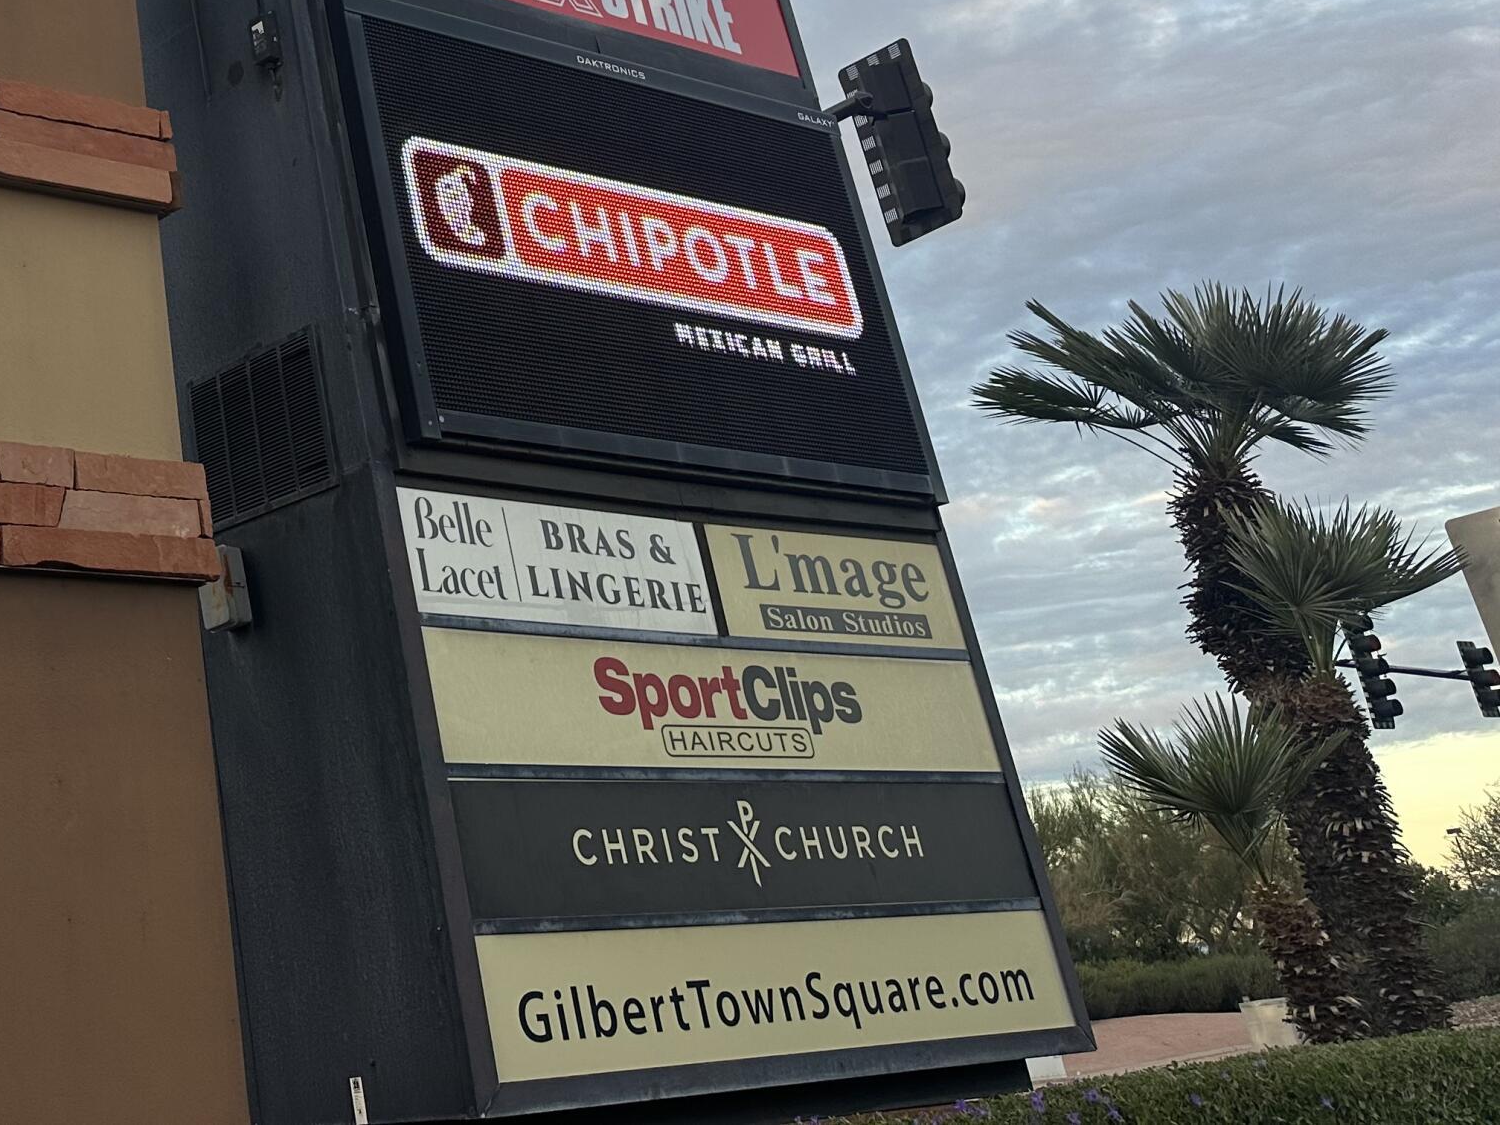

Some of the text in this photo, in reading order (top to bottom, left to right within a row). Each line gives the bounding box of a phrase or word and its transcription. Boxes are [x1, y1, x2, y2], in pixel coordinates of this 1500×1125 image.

[576, 55, 646, 80] DAKTRONICS
[797, 111, 833, 127] GALAXY
[521, 192, 839, 306] CHIPOTLE
[674, 322, 784, 362] MEXICAN
[415, 497, 493, 548] Belle
[544, 518, 676, 565] BRAS &
[416, 547, 509, 601] Lacet
[526, 564, 708, 615] LINGERIE
[731, 532, 930, 609] L'mage
[766, 606, 927, 638] Salon Studios
[669, 730, 808, 754] HAIRCUTS
[572, 824, 925, 866] CHRIST CHURCH
[518, 964, 1036, 1044] GilbertTownSquare.com
